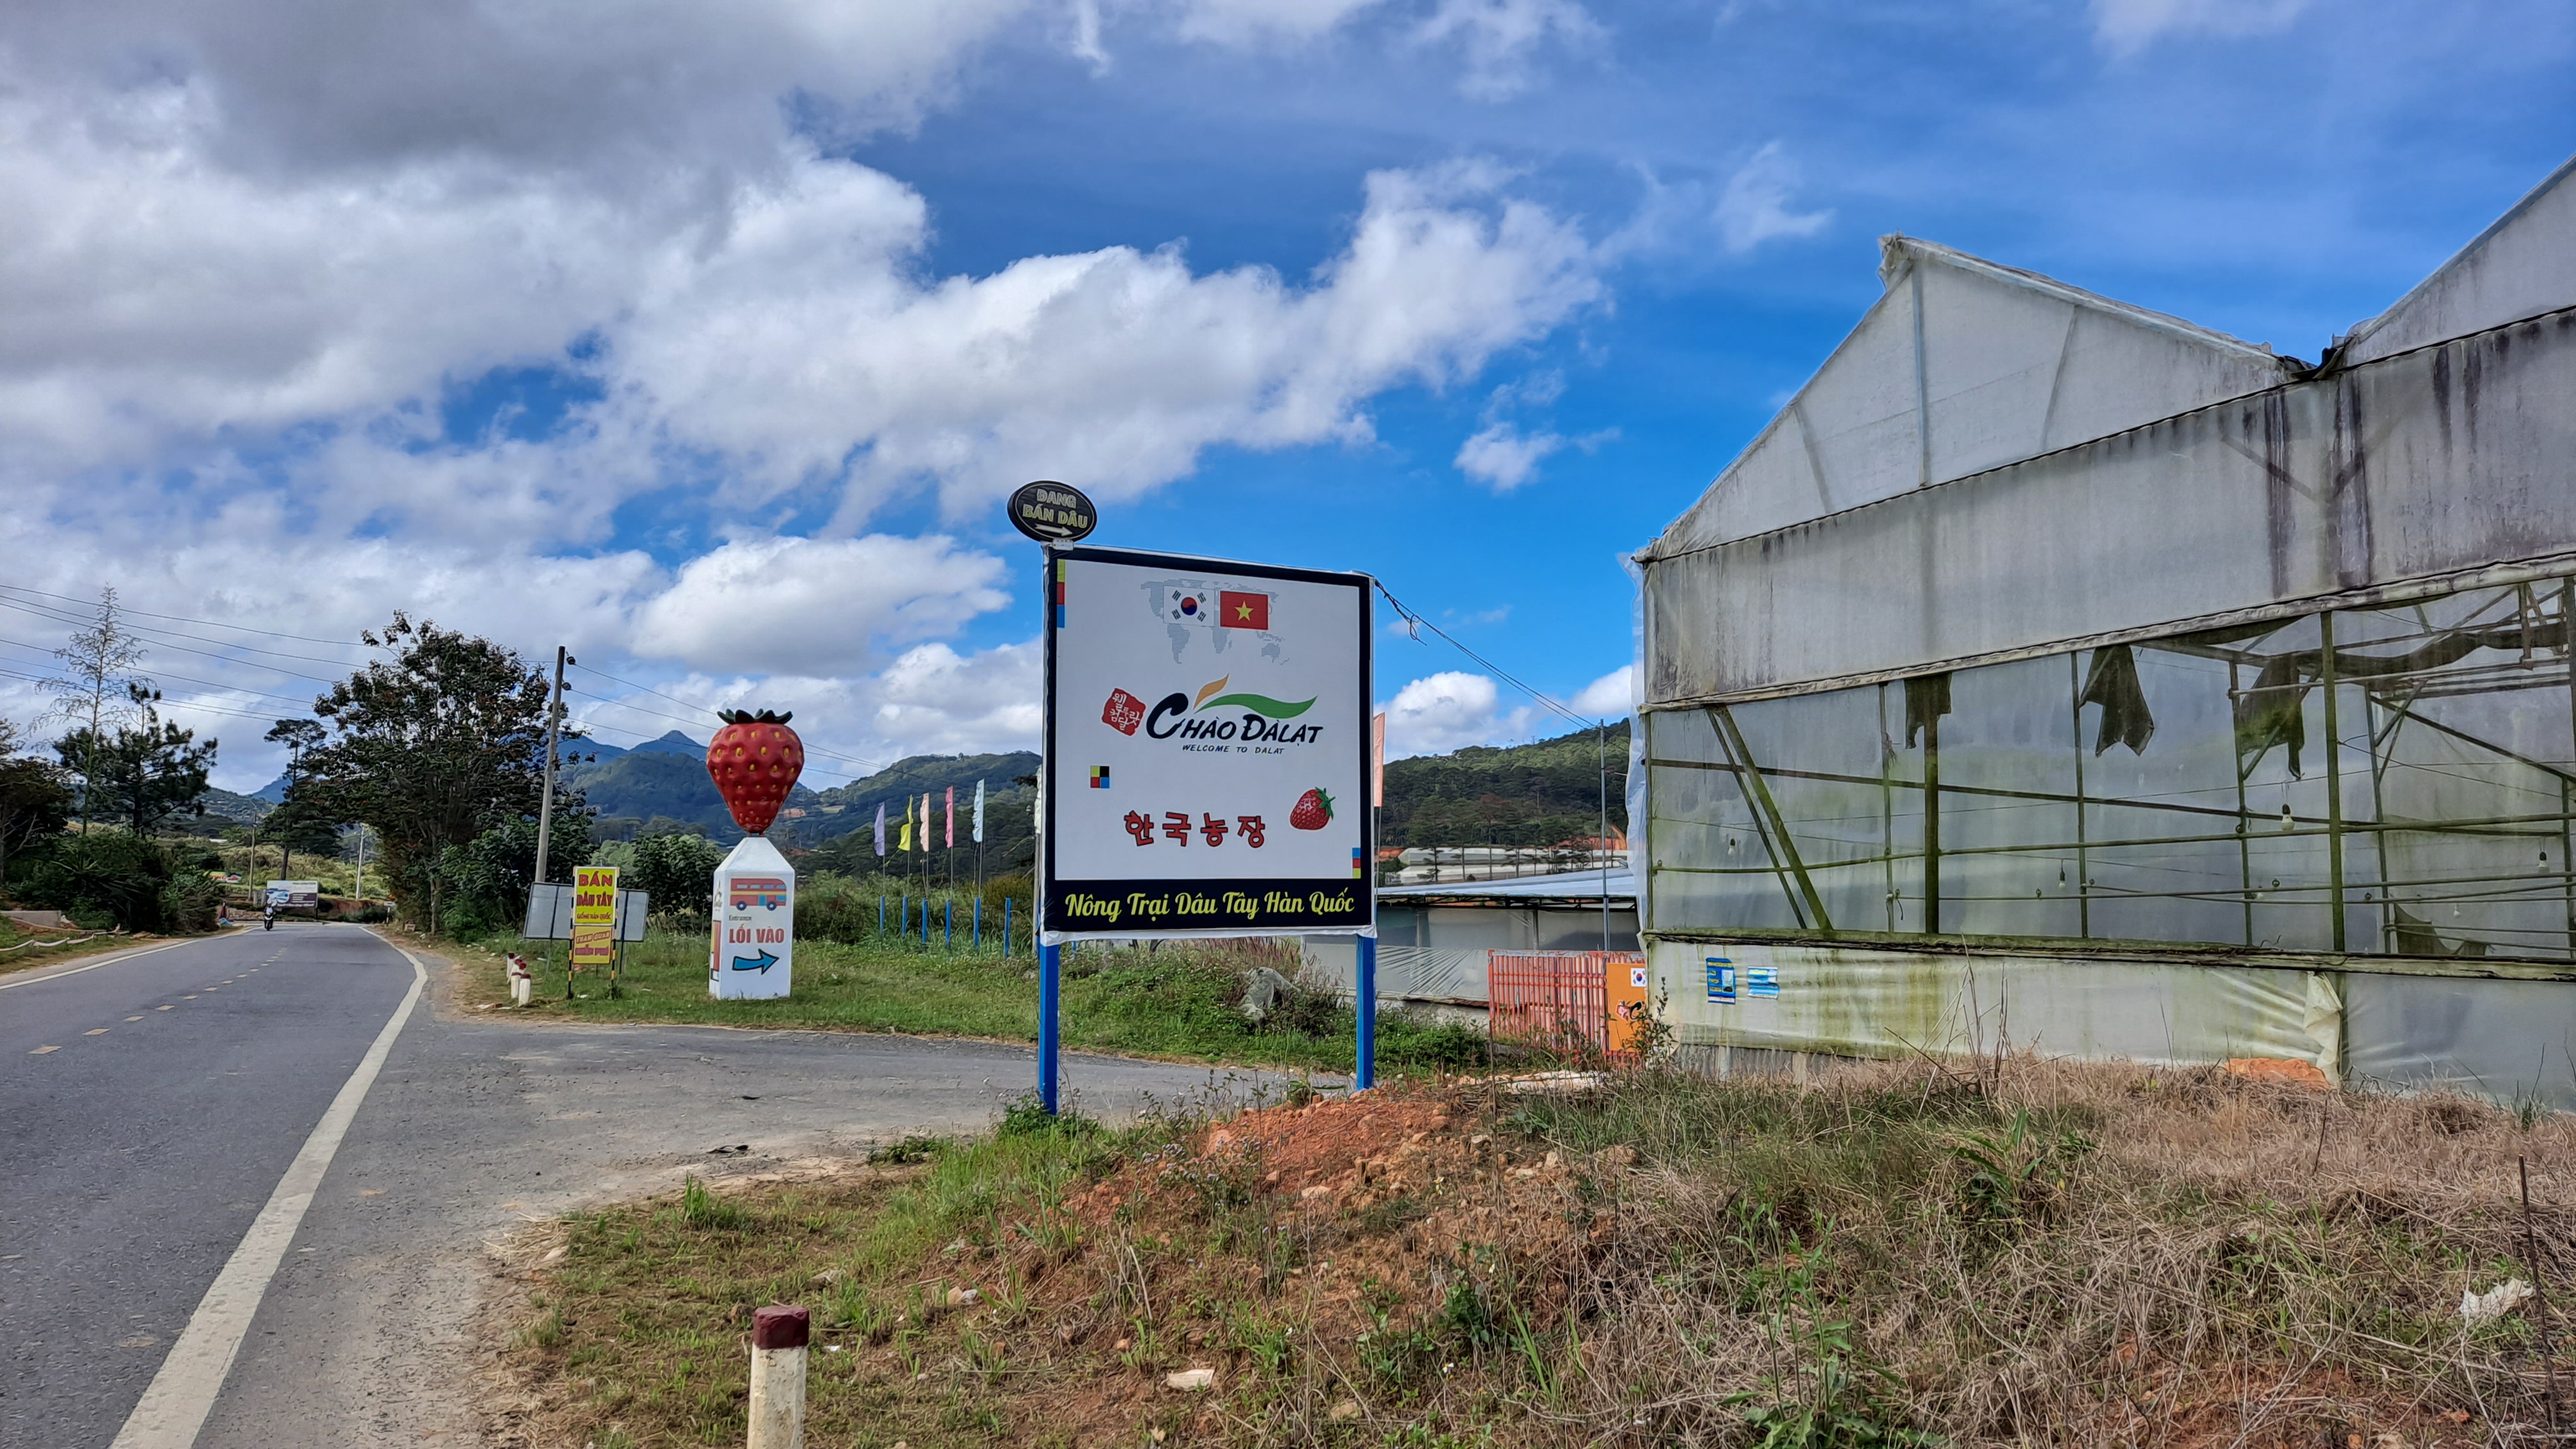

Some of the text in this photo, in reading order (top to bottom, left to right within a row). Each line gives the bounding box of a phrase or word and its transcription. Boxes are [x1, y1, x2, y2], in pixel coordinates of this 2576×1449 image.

[1036, 488, 1077, 509] ĐANG
[1022, 504, 1088, 528] BÁN DÂU
[1182, 744, 1230, 753] WELCOME
[1255, 746, 1285, 755] DALAT
[1124, 810, 1265, 848] 한국농장
[578, 870, 613, 887] BÁN
[576, 891, 614, 906] DÂU TÂY
[1065, 887, 1355, 923] Nông Trại Dâu Tây Hàn Quốc
[728, 923, 785, 943] LỐI VÀO
